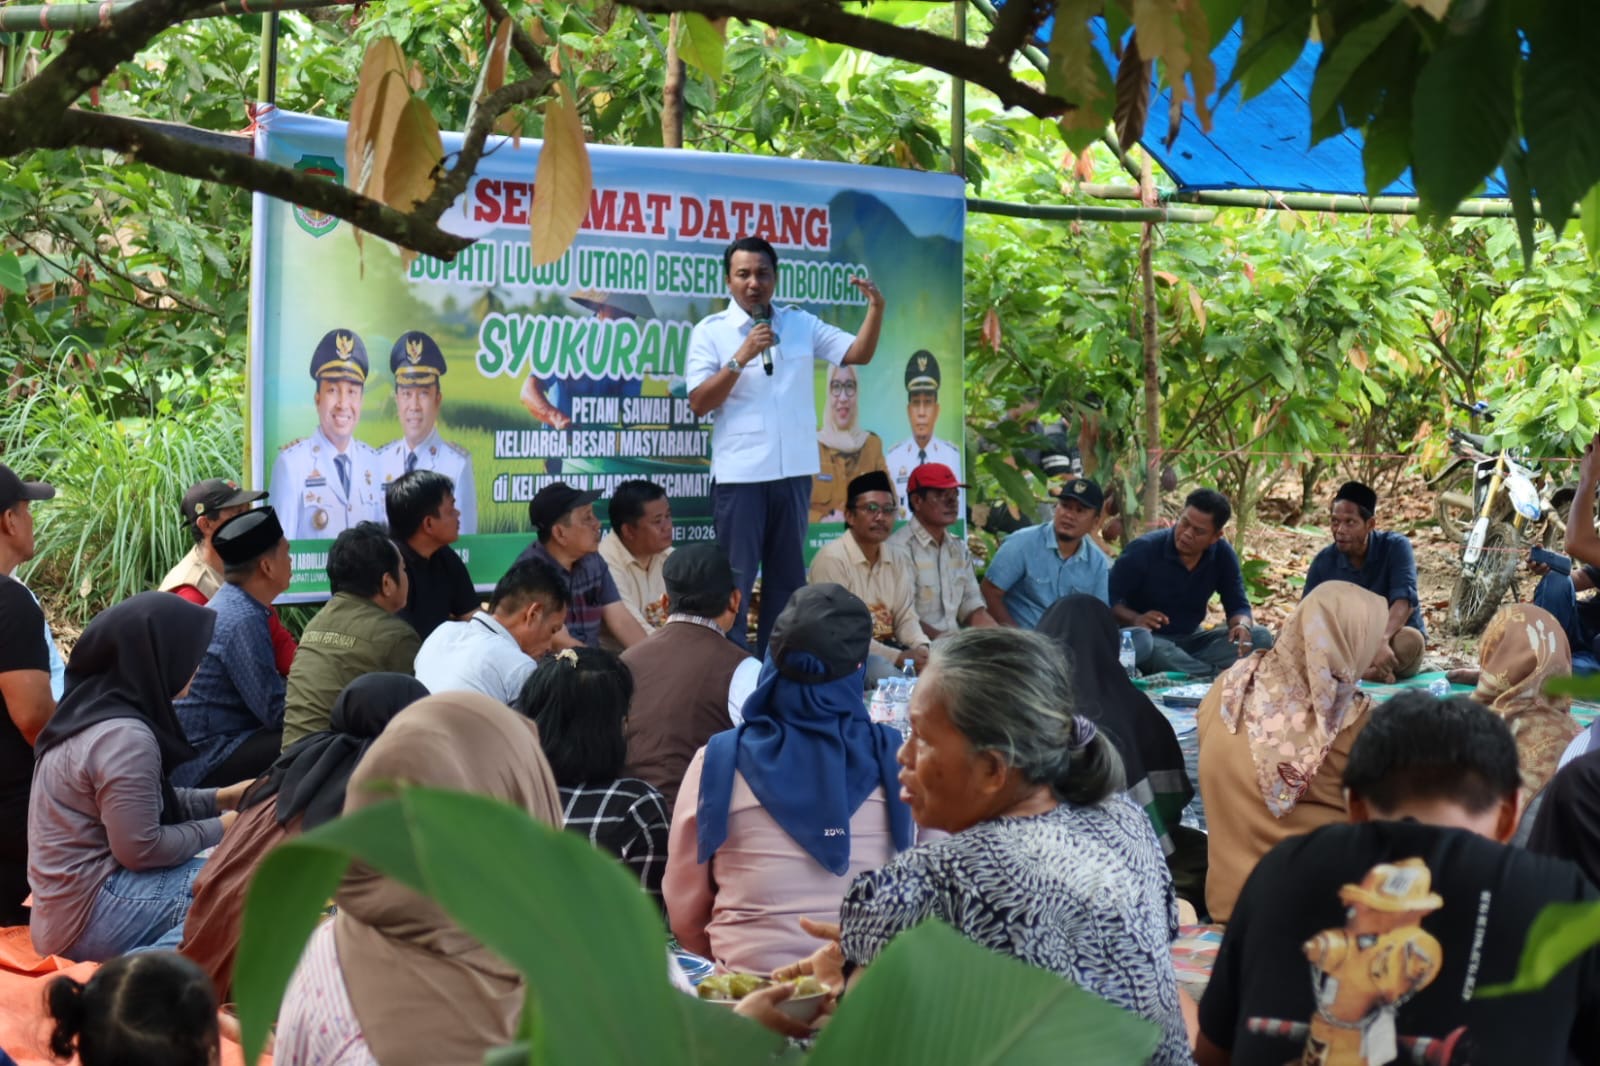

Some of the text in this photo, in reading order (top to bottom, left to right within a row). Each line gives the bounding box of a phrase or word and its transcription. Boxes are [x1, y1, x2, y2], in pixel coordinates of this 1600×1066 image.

[474, 178, 829, 248] SEMAT DATANG
[579, 250, 647, 290] UTARA
[657, 255, 727, 294] BESERT
[775, 263, 867, 302] MBONGAN
[479, 315, 693, 376] SYUKURAN
[572, 397, 618, 424] PETANI
[622, 397, 671, 424] SAWAH
[495, 431, 709, 458] KELUARGA BESAR MASYARAKAT
[494, 475, 508, 501] di
[688, 526, 717, 540] 2026
